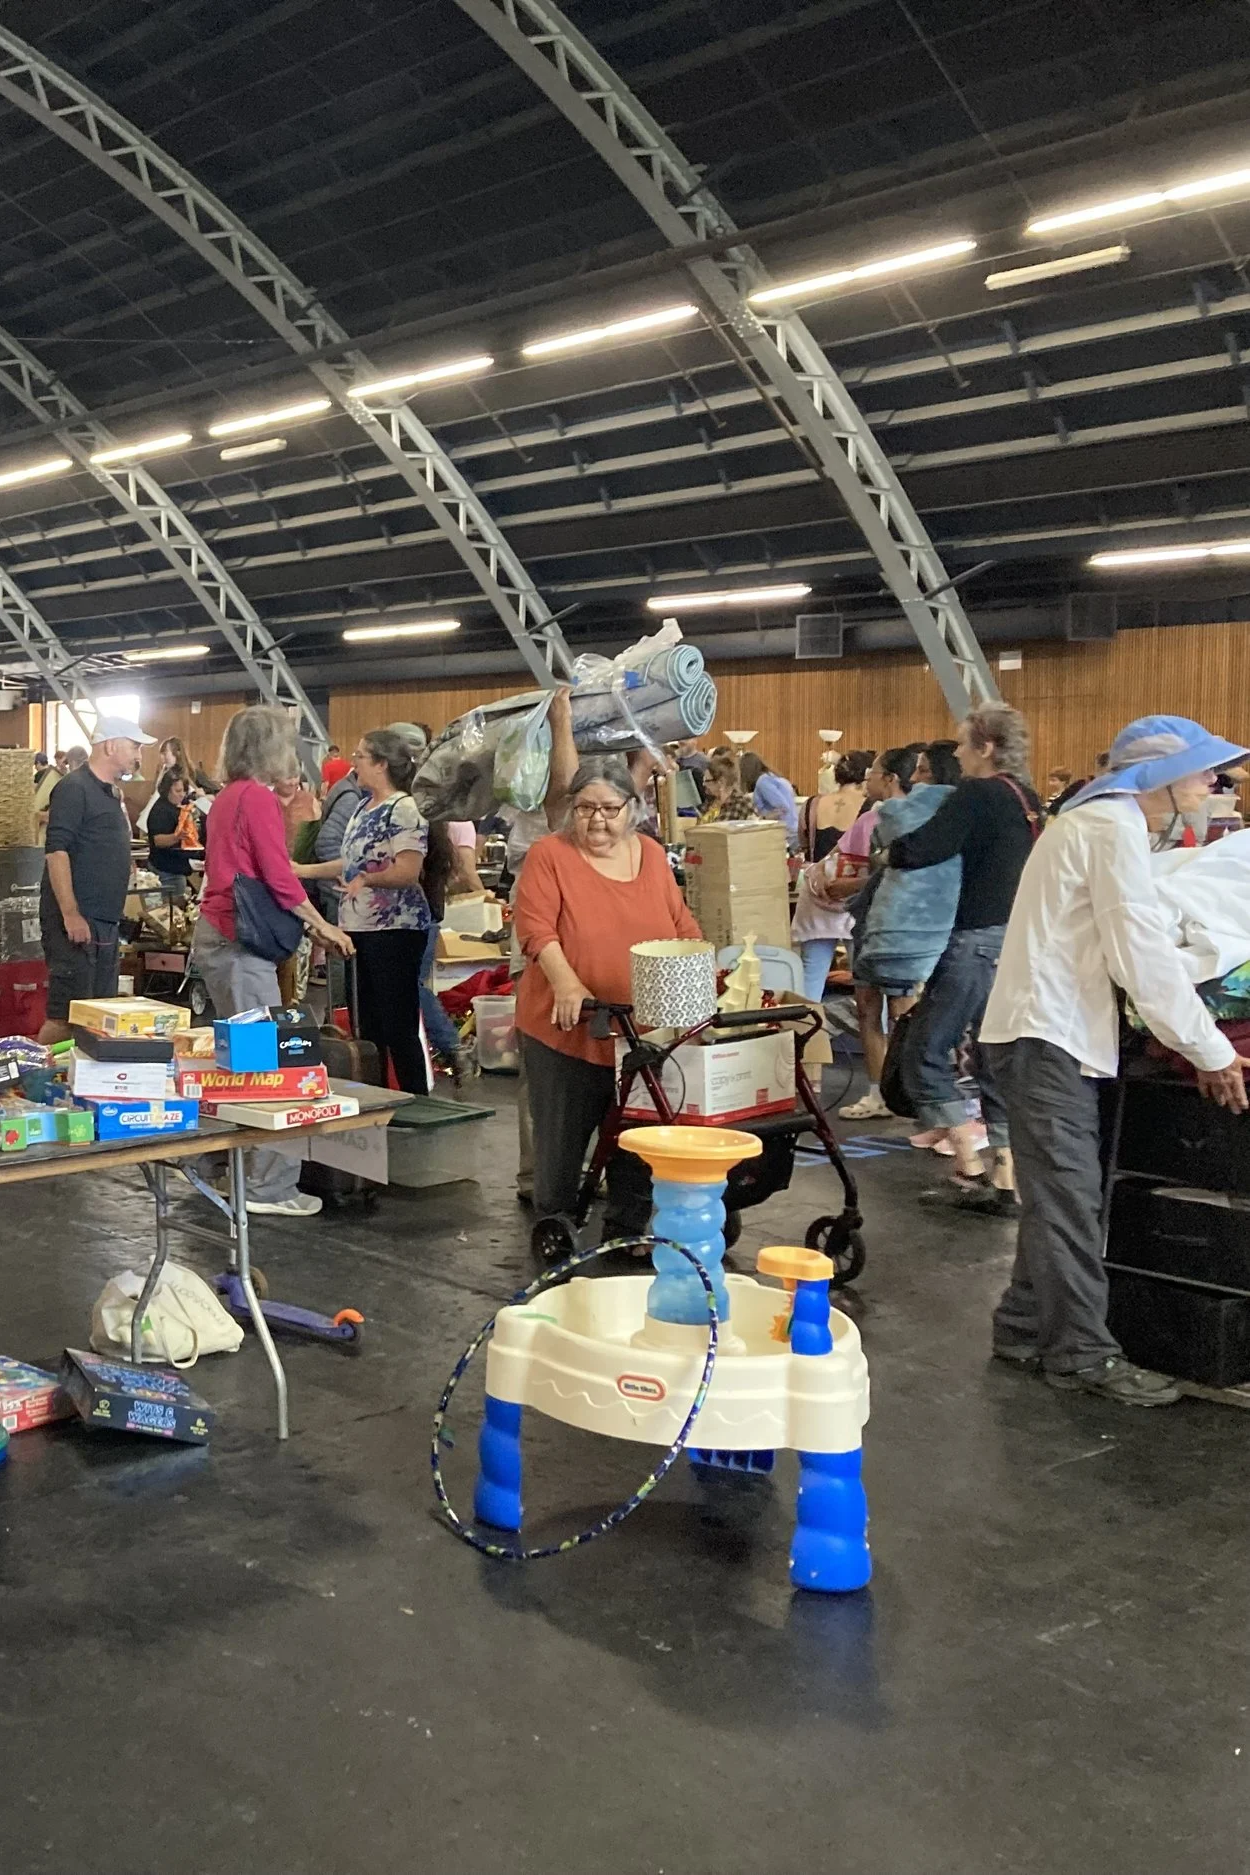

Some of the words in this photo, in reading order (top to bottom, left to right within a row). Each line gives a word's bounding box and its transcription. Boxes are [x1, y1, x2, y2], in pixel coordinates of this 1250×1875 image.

[201, 1072, 245, 1088] World
[250, 1073, 285, 1089] Map
[159, 1111, 181, 1122] AZE
[288, 1105, 339, 1124] MONOPOLY
[134, 1400, 164, 1415] WITS
[128, 1411, 176, 1429] WAGERS
